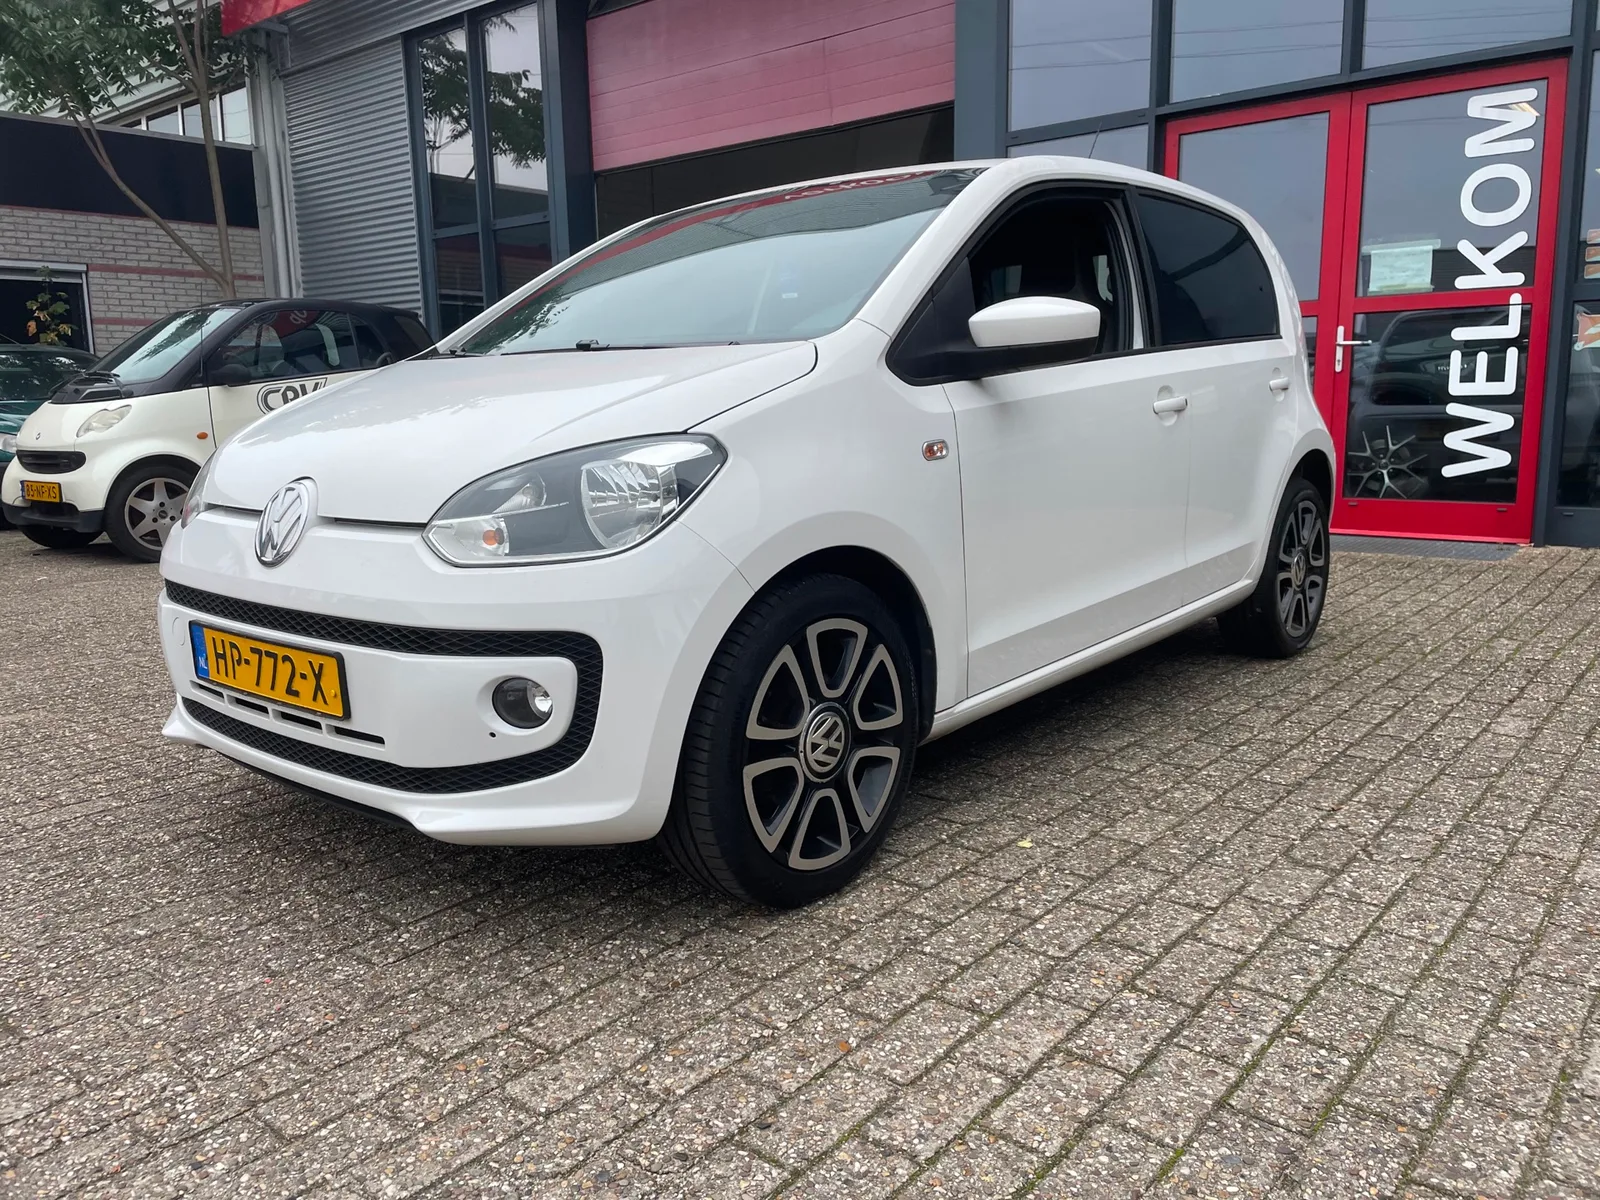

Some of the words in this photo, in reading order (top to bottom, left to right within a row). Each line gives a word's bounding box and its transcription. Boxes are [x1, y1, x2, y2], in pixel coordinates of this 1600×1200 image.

[1441, 87, 1539, 478] WELKOM
[198, 656, 208, 669] NL
[212, 637, 329, 705] HP-772-X
